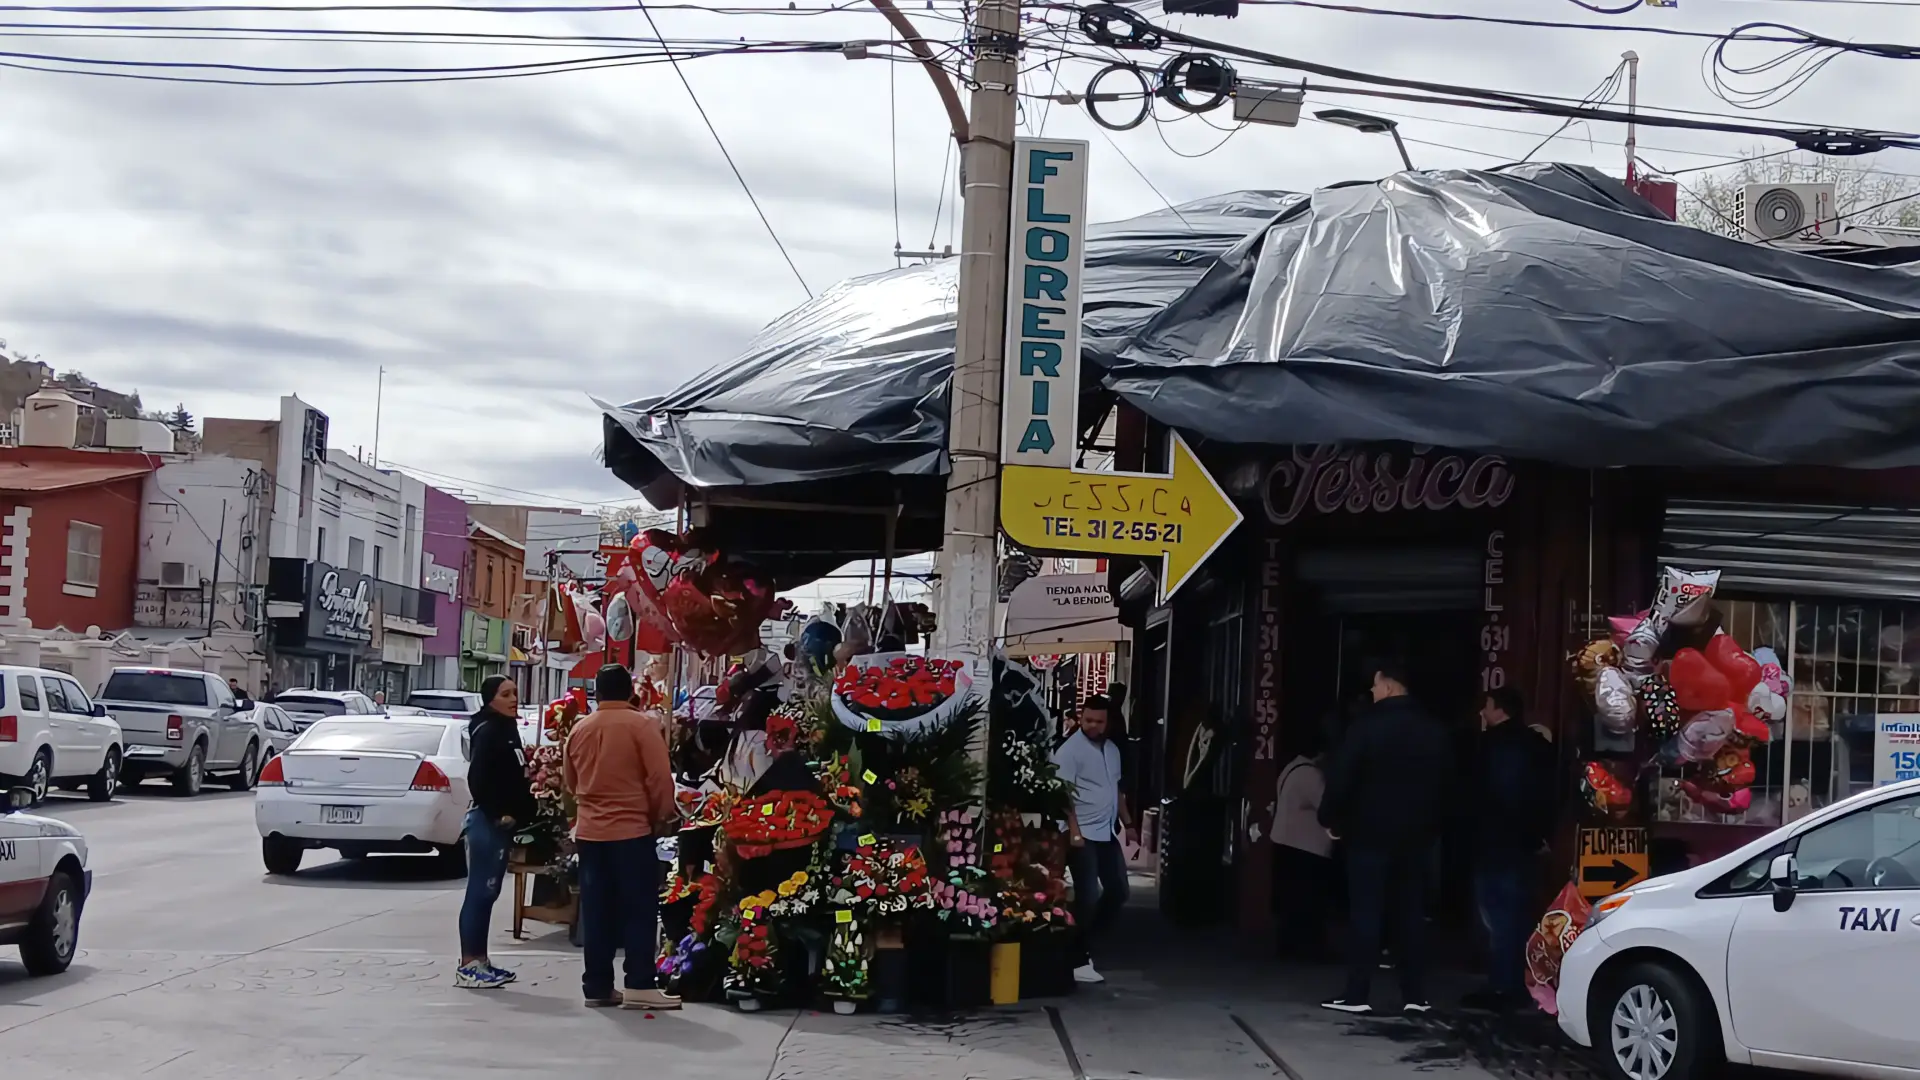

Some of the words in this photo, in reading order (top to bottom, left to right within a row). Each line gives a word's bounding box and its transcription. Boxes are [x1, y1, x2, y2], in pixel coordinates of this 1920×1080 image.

[1016, 149, 1074, 454] FLORERIA
[1042, 516, 1081, 537] TEL
[1046, 586, 1082, 596] TIENDA
[1839, 906, 1901, 932] TAXI
